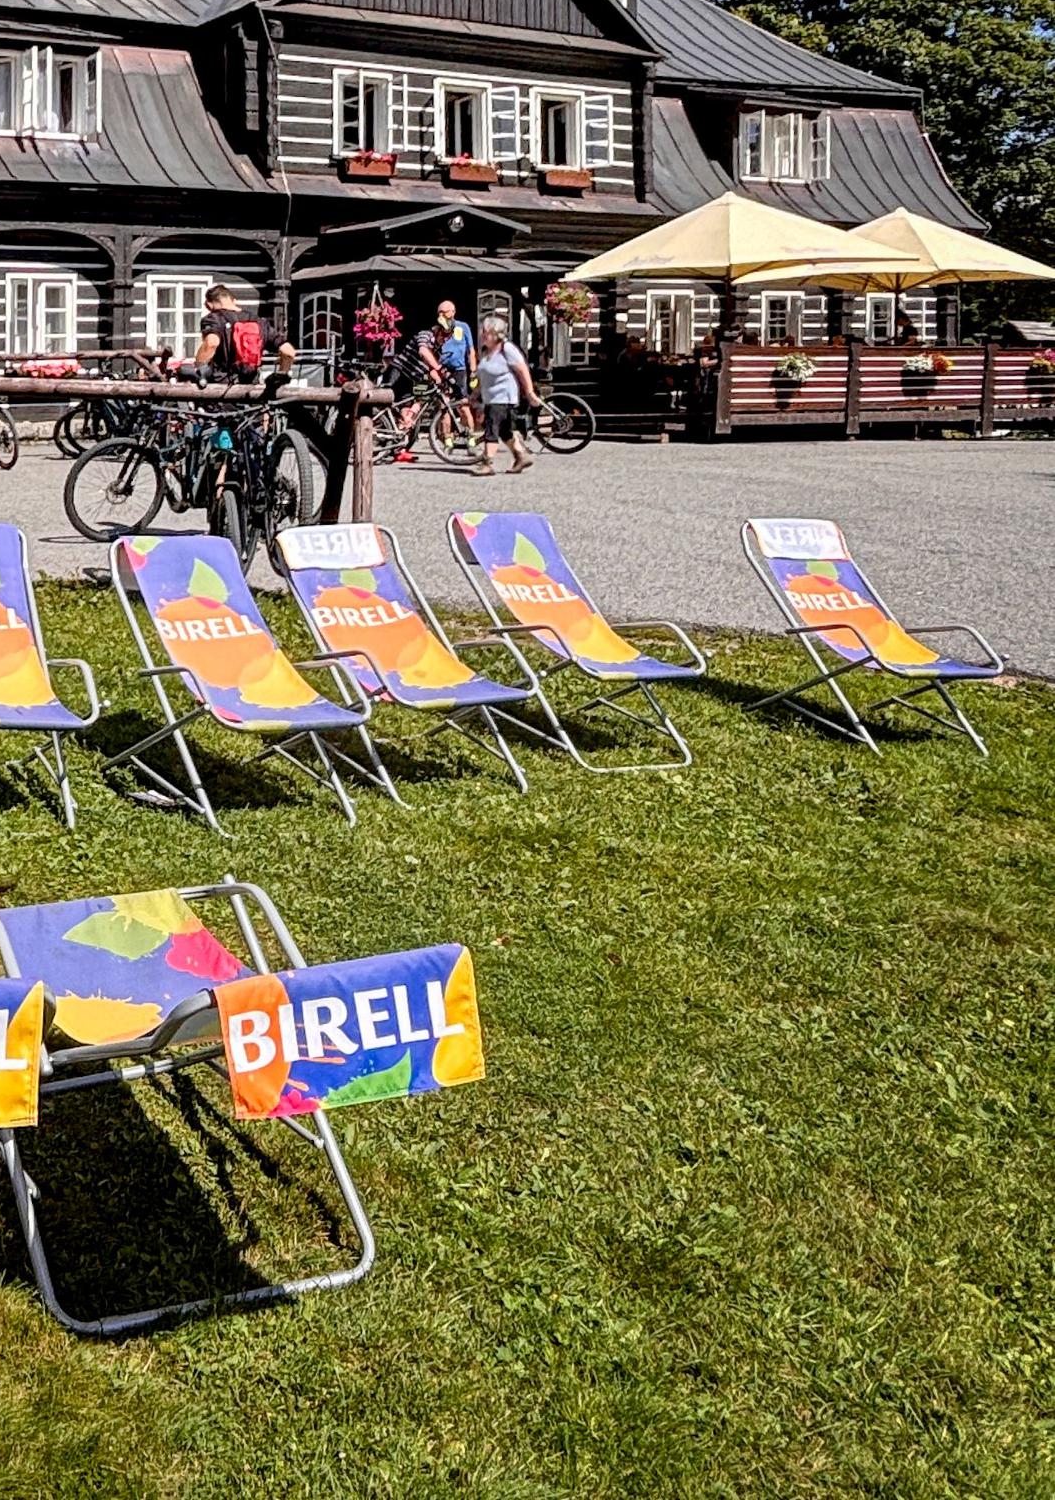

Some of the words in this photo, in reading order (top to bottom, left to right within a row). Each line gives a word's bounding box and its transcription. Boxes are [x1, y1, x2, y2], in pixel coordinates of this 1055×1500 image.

[491, 580, 580, 604] BIRELL
[785, 590, 873, 612] BIRELL
[154, 614, 263, 641] BIRELL
[311, 601, 414, 628] BIRELL
[228, 981, 465, 1073] BIRELL
